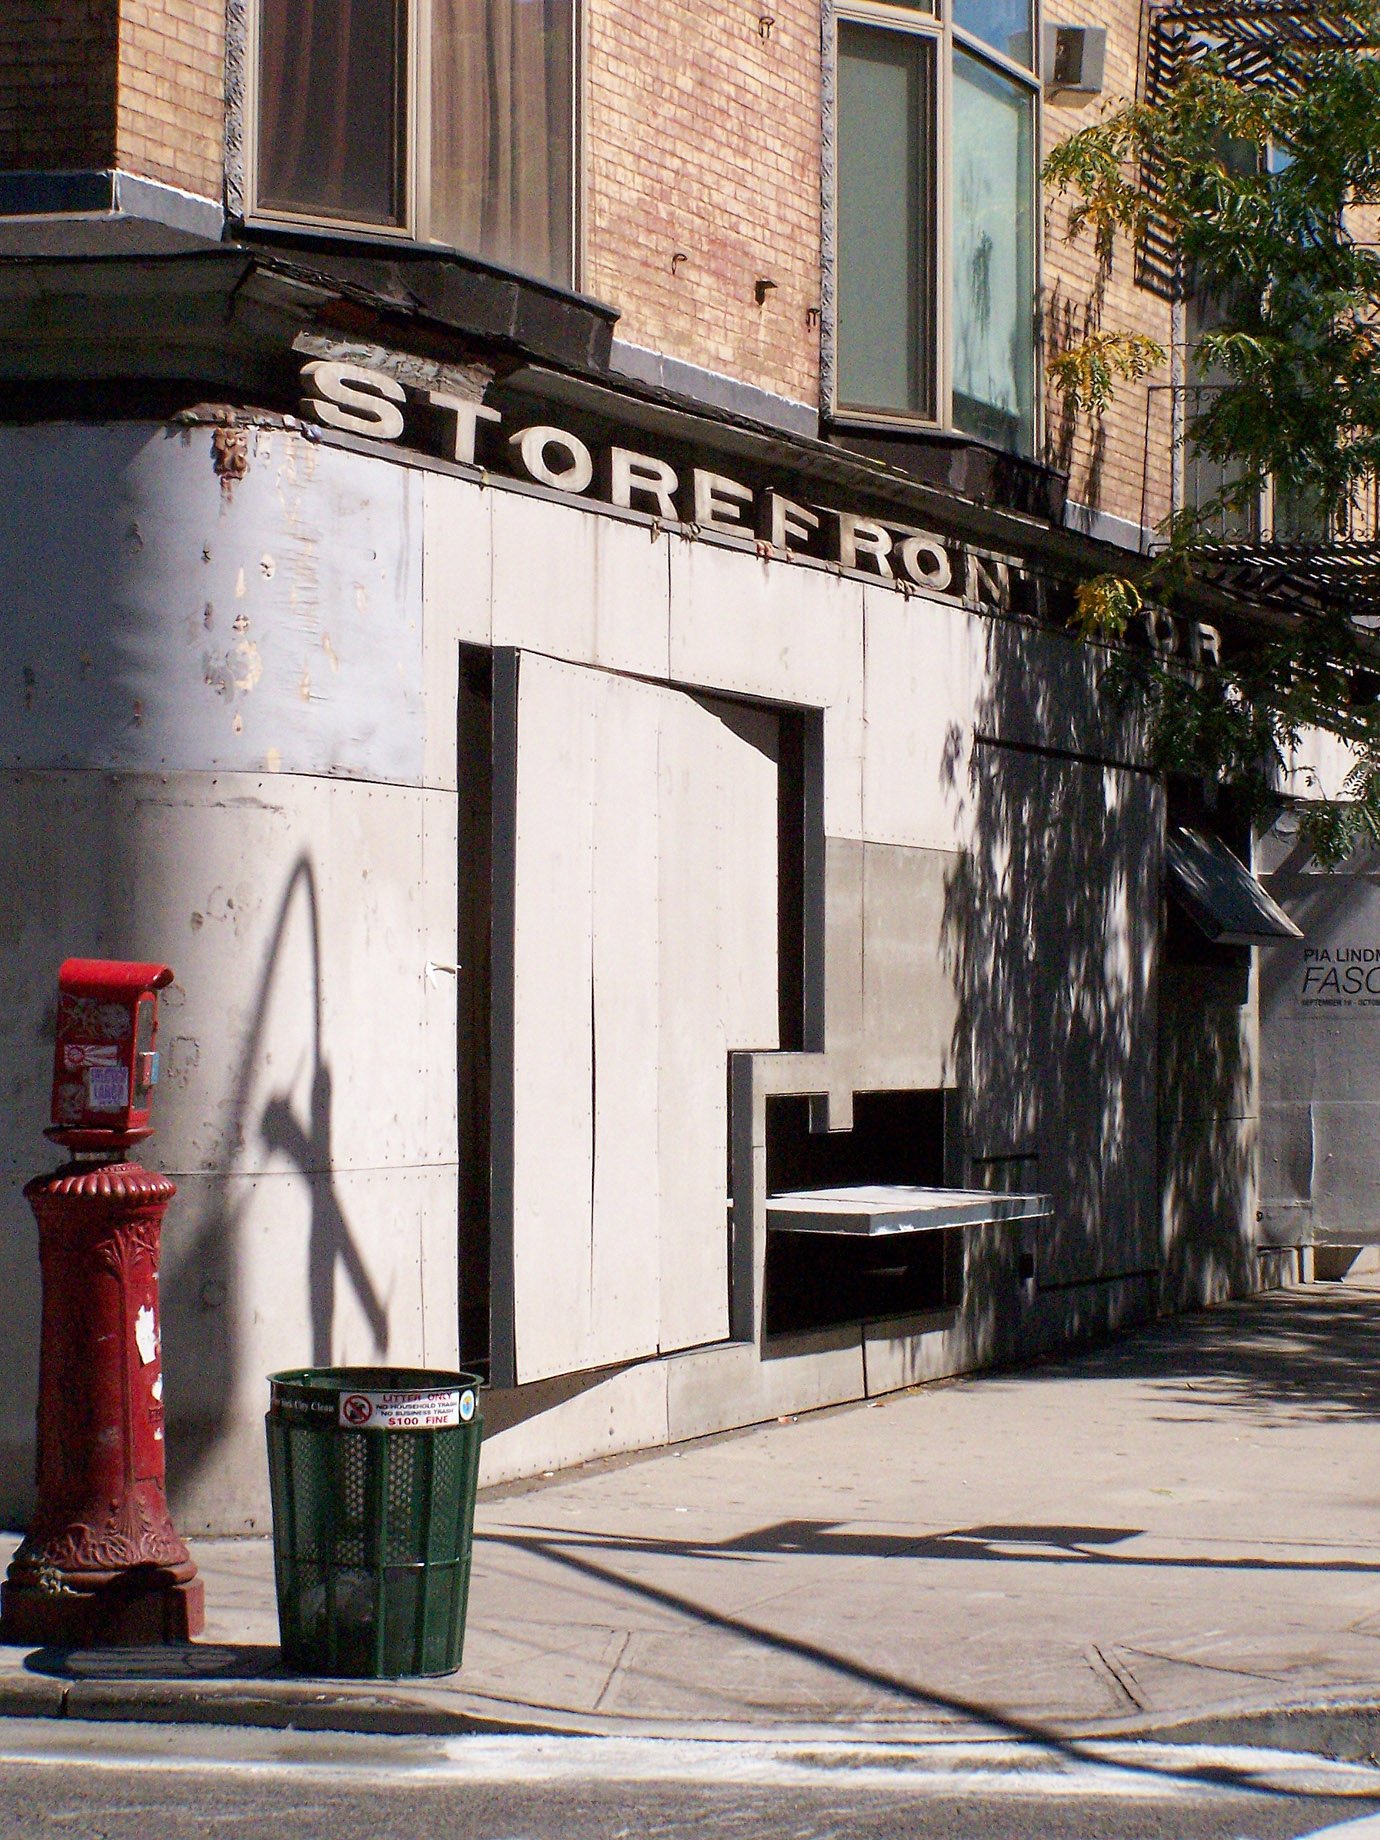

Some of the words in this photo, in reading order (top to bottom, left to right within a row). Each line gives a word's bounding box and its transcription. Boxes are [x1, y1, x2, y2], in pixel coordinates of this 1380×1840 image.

[1304, 949, 1331, 962] PIA
[383, 1393, 421, 1403] LITTER
[428, 1392, 453, 1401] ONLY
[388, 1417, 419, 1426] $100
[426, 1415, 448, 1424] FINE
